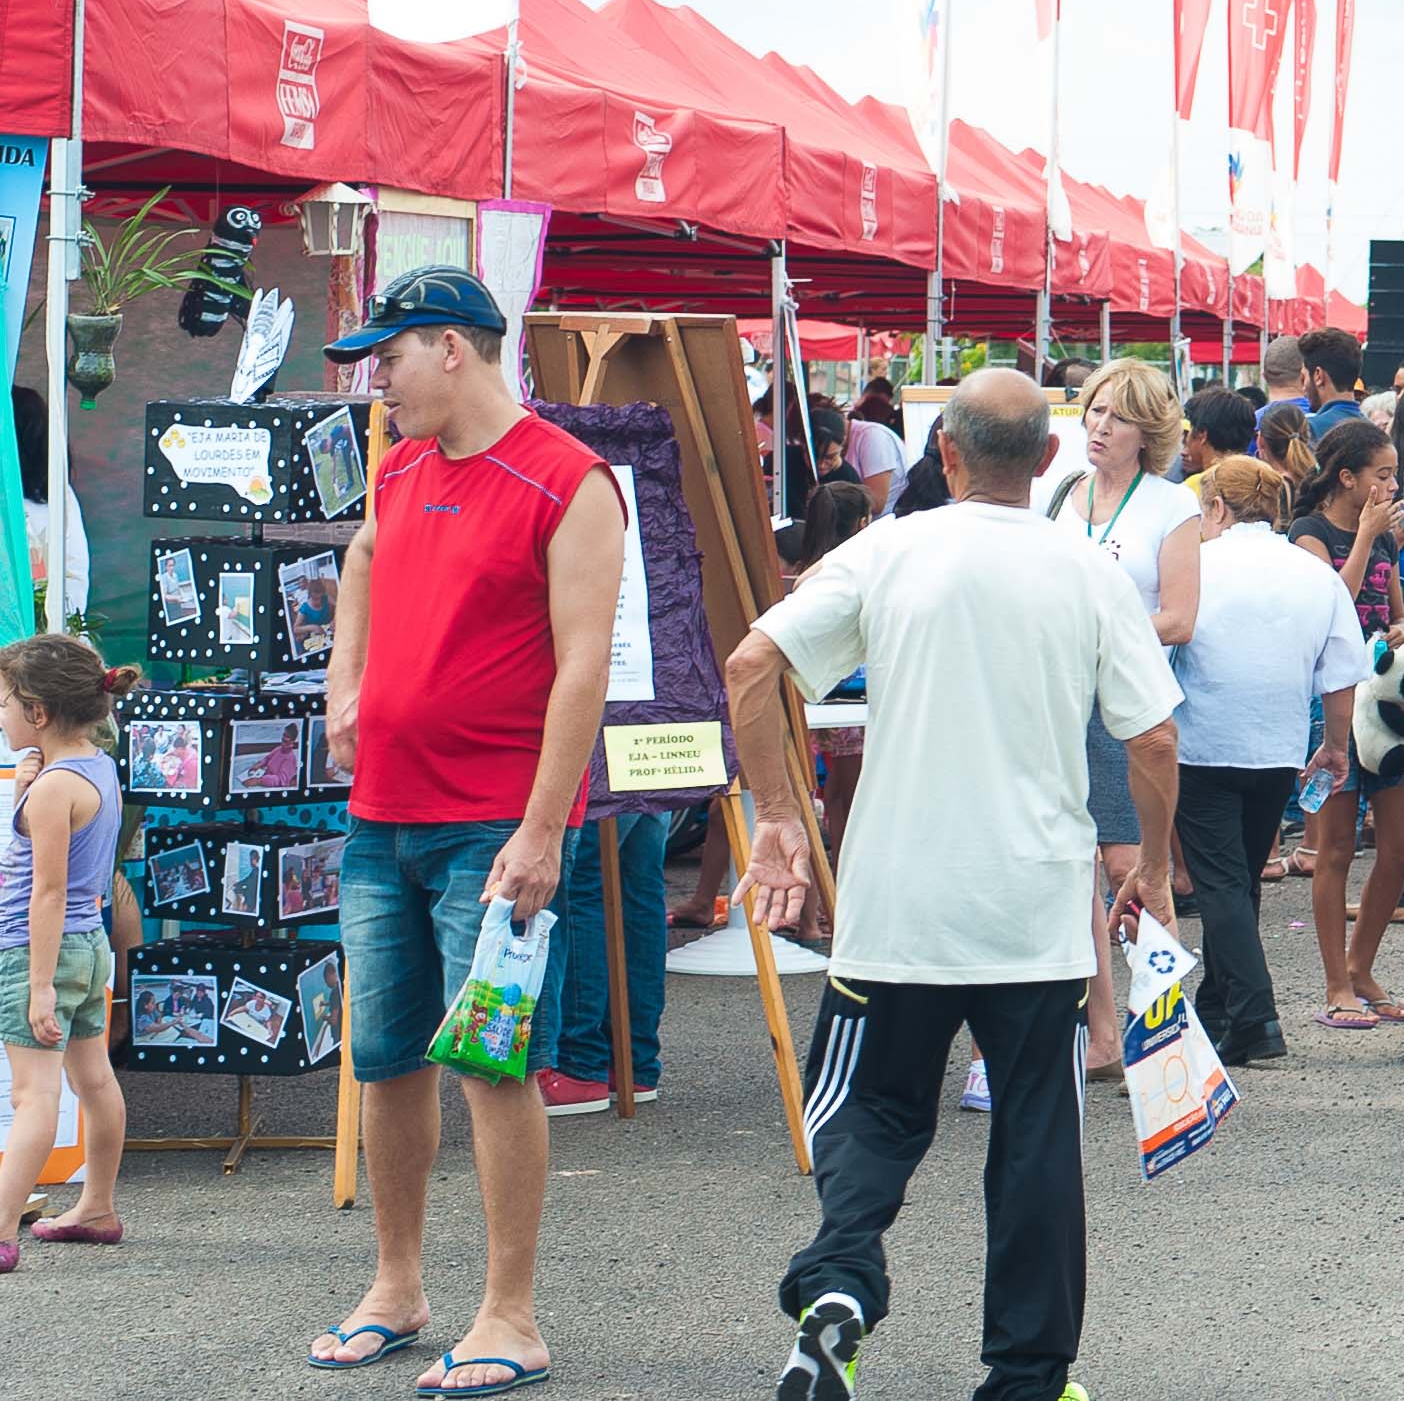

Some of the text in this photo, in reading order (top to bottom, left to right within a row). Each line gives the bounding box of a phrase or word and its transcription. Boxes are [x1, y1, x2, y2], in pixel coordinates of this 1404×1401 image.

[215, 432, 250, 443] MARIA
[254, 431, 267, 443] DE
[194, 449, 261, 461] LOURDES EM
